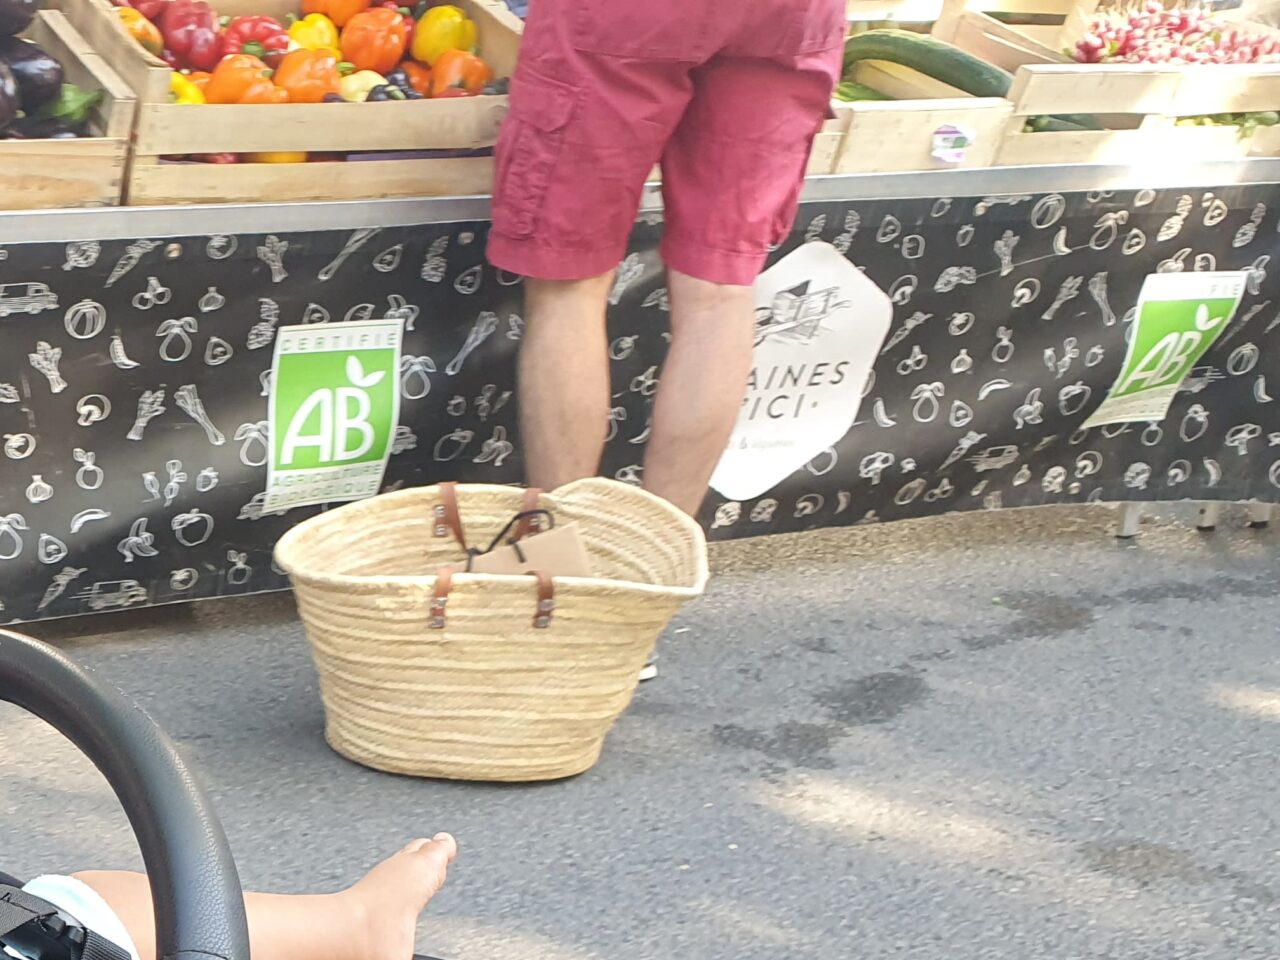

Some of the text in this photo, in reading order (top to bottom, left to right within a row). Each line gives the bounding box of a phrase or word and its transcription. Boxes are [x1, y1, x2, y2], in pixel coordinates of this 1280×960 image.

[745, 360, 851, 391] AINES
[1118, 330, 1202, 393] AB
[279, 387, 376, 465] AB
[741, 393, 806, 421] 'ICI
